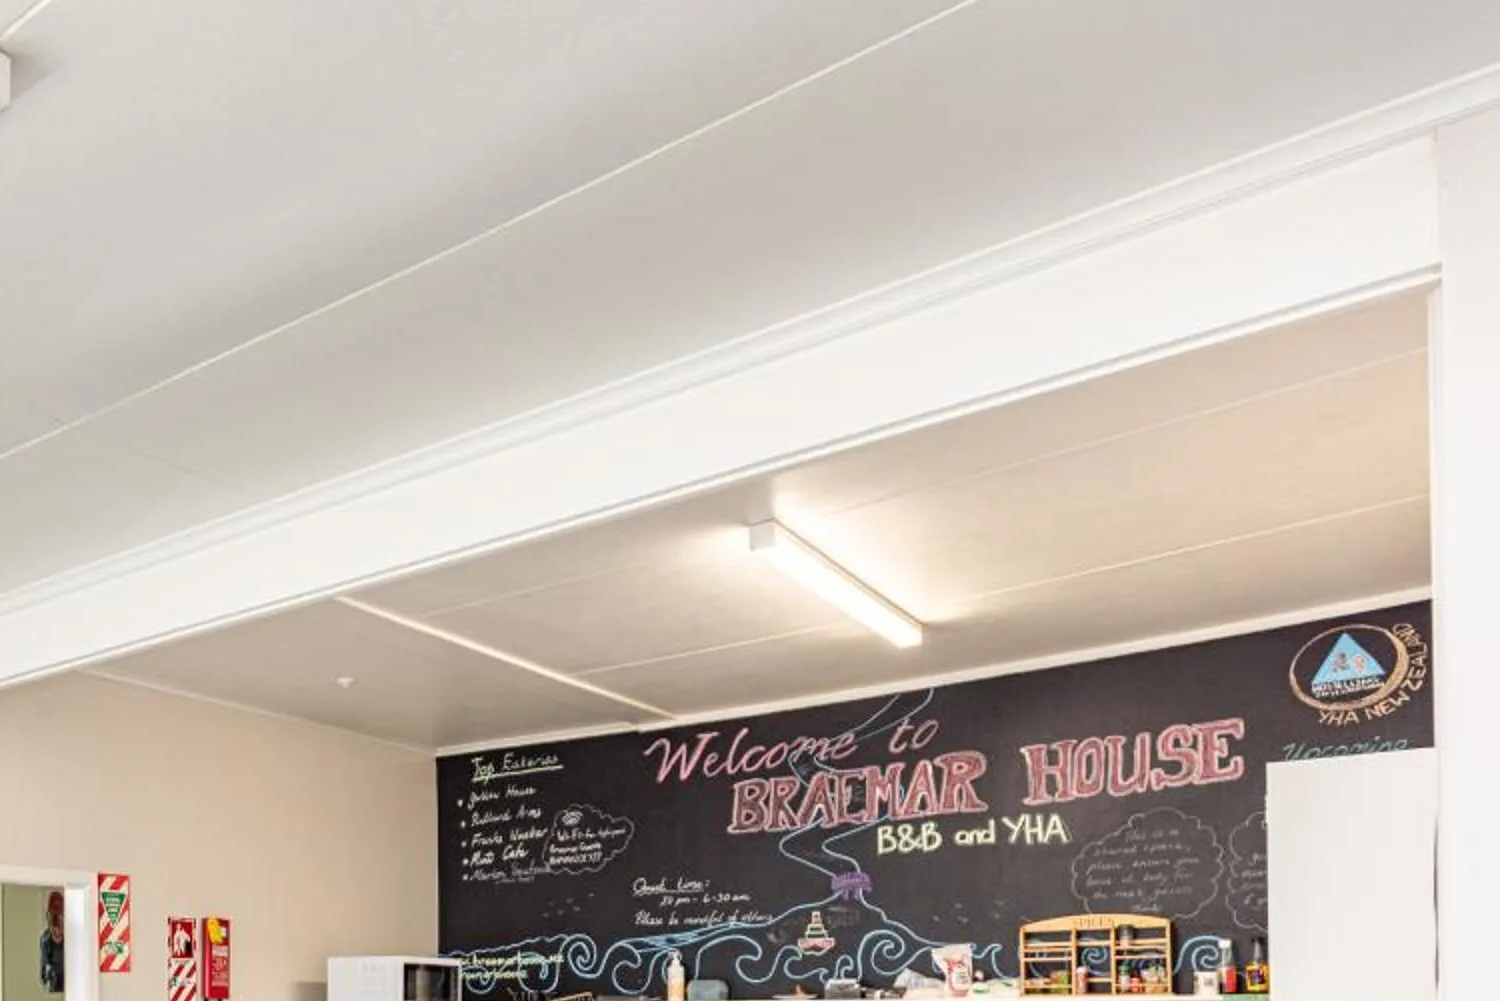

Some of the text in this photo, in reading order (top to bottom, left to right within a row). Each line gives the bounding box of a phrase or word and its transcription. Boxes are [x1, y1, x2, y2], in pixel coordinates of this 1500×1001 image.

[1317, 622, 1428, 727] YHA NEW ZEALAND
[471, 757, 496, 786] Top
[644, 717, 940, 784] Welcome to
[727, 718, 1246, 835] BRAEMAR HOUSE
[876, 812, 1073, 856] B&B and YHA
